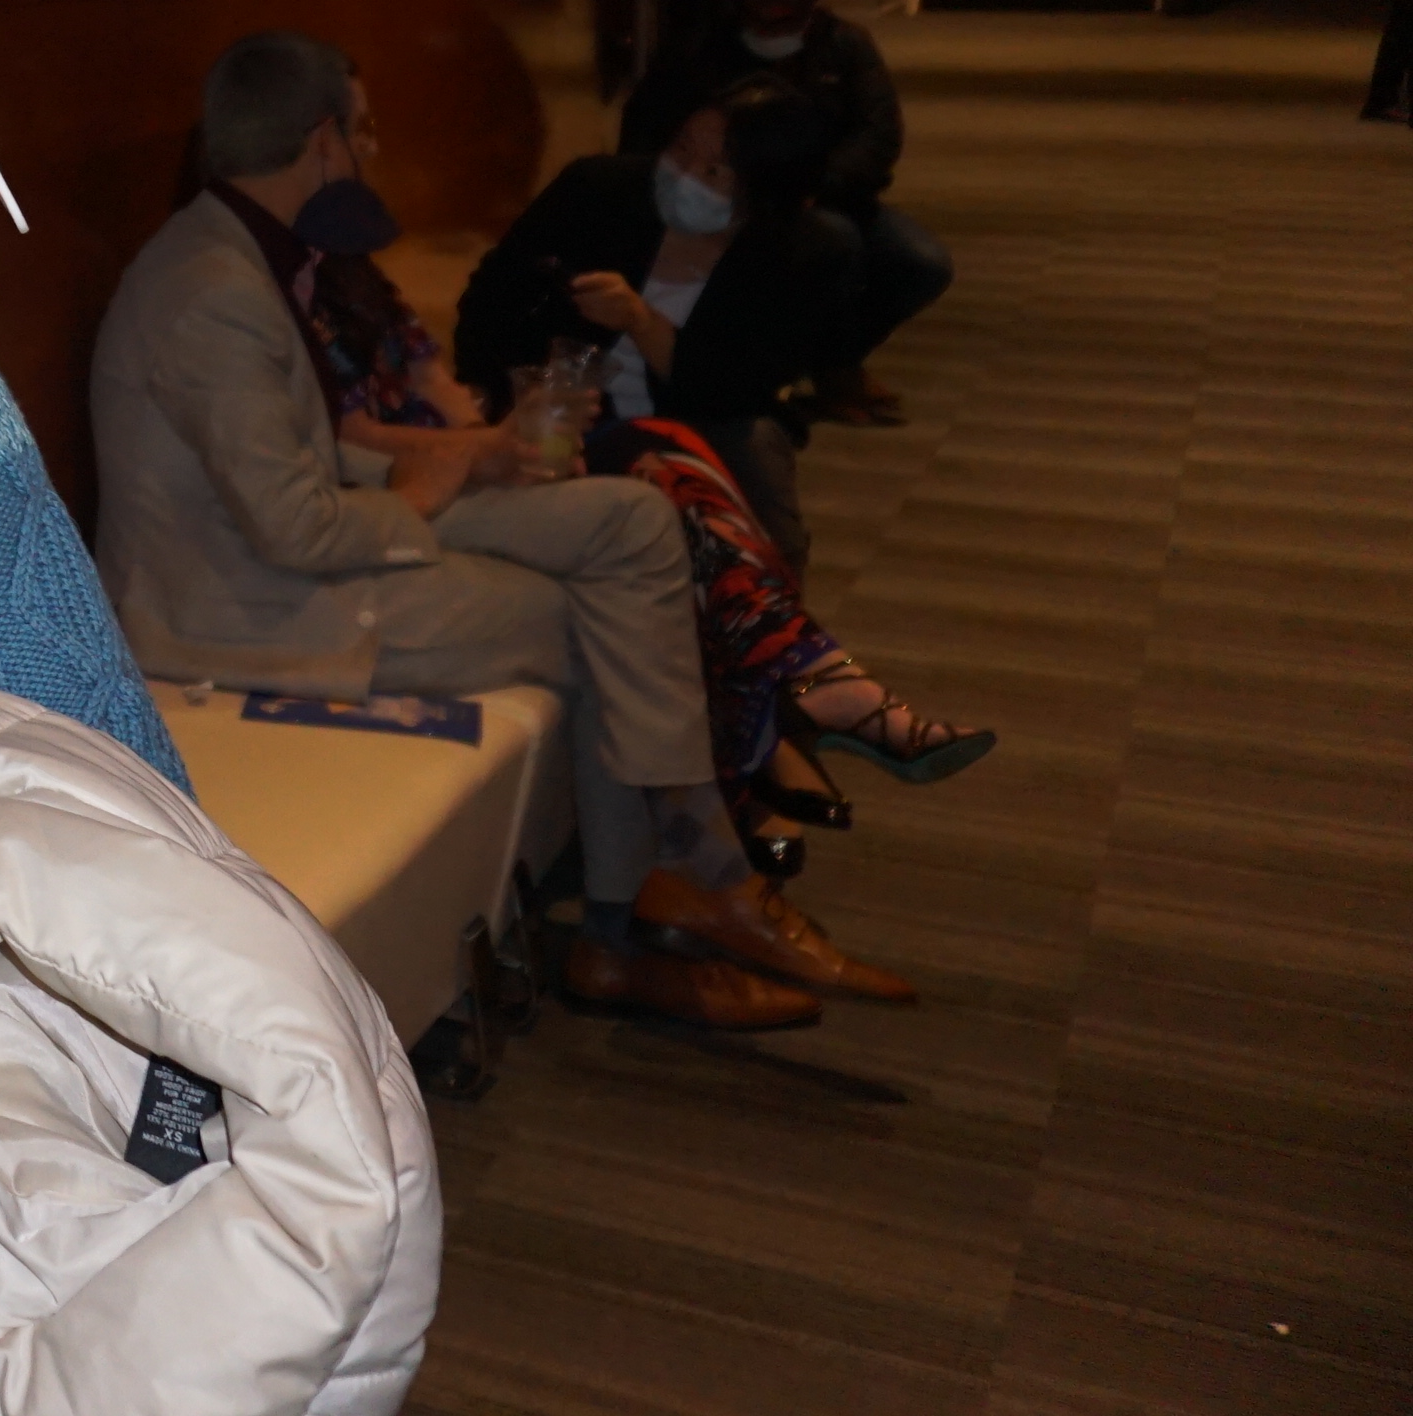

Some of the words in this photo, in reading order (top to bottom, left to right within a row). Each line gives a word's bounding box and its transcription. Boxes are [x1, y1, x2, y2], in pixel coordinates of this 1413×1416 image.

[142, 1132, 164, 1145] MADE
[166, 1140, 176, 1150] IN
[177, 1143, 201, 1157] CHINA
[163, 1127, 183, 1142] XS
